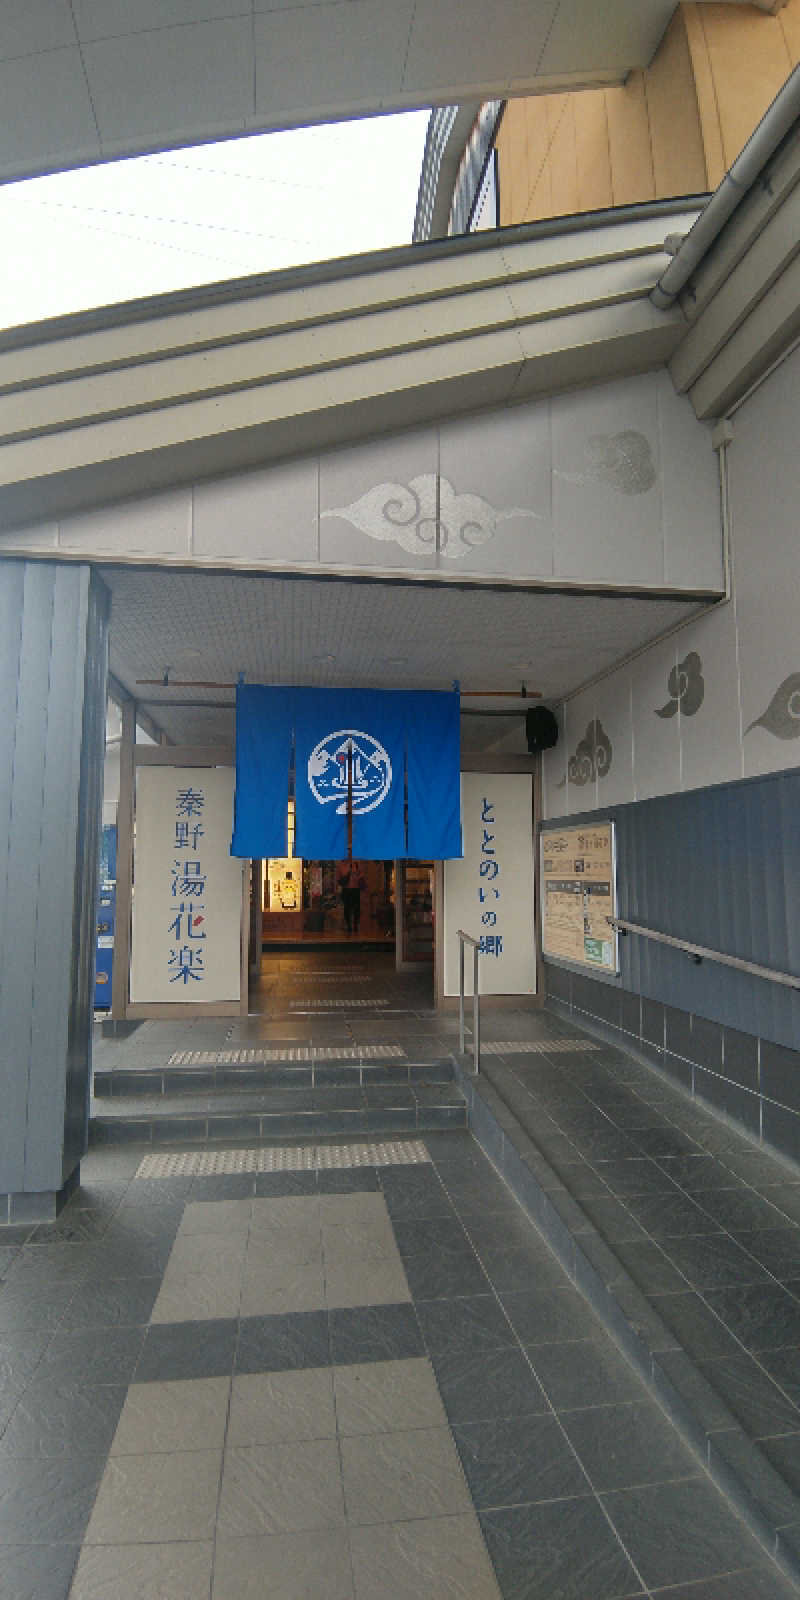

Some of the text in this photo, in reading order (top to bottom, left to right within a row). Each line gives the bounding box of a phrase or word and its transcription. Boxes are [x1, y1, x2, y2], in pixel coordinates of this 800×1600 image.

[168, 788, 207, 984] 秦野湯花楽
[478, 797, 503, 957] ととのいの郷
